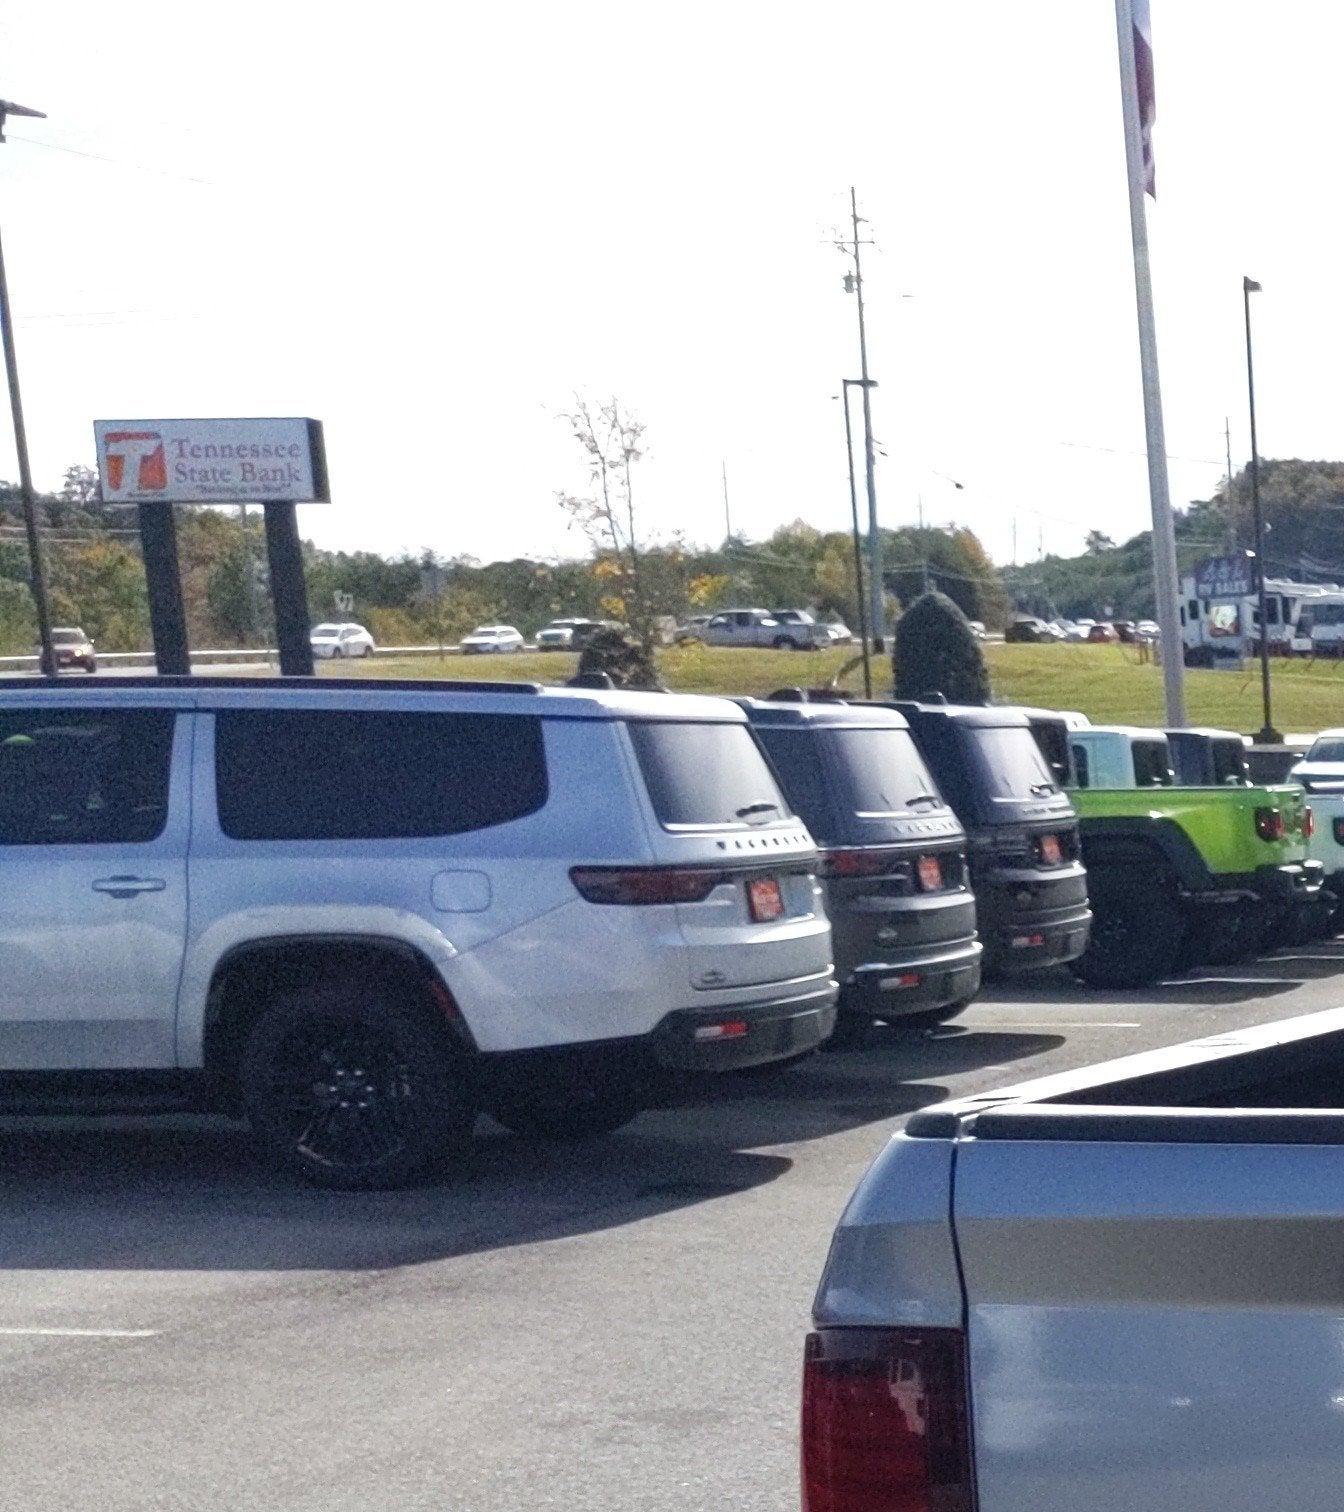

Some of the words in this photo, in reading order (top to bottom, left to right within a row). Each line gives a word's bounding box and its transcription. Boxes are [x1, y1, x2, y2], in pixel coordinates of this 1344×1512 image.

[171, 438, 300, 458] Tennessee
[174, 463, 231, 482] State
[241, 462, 301, 482] Bank
